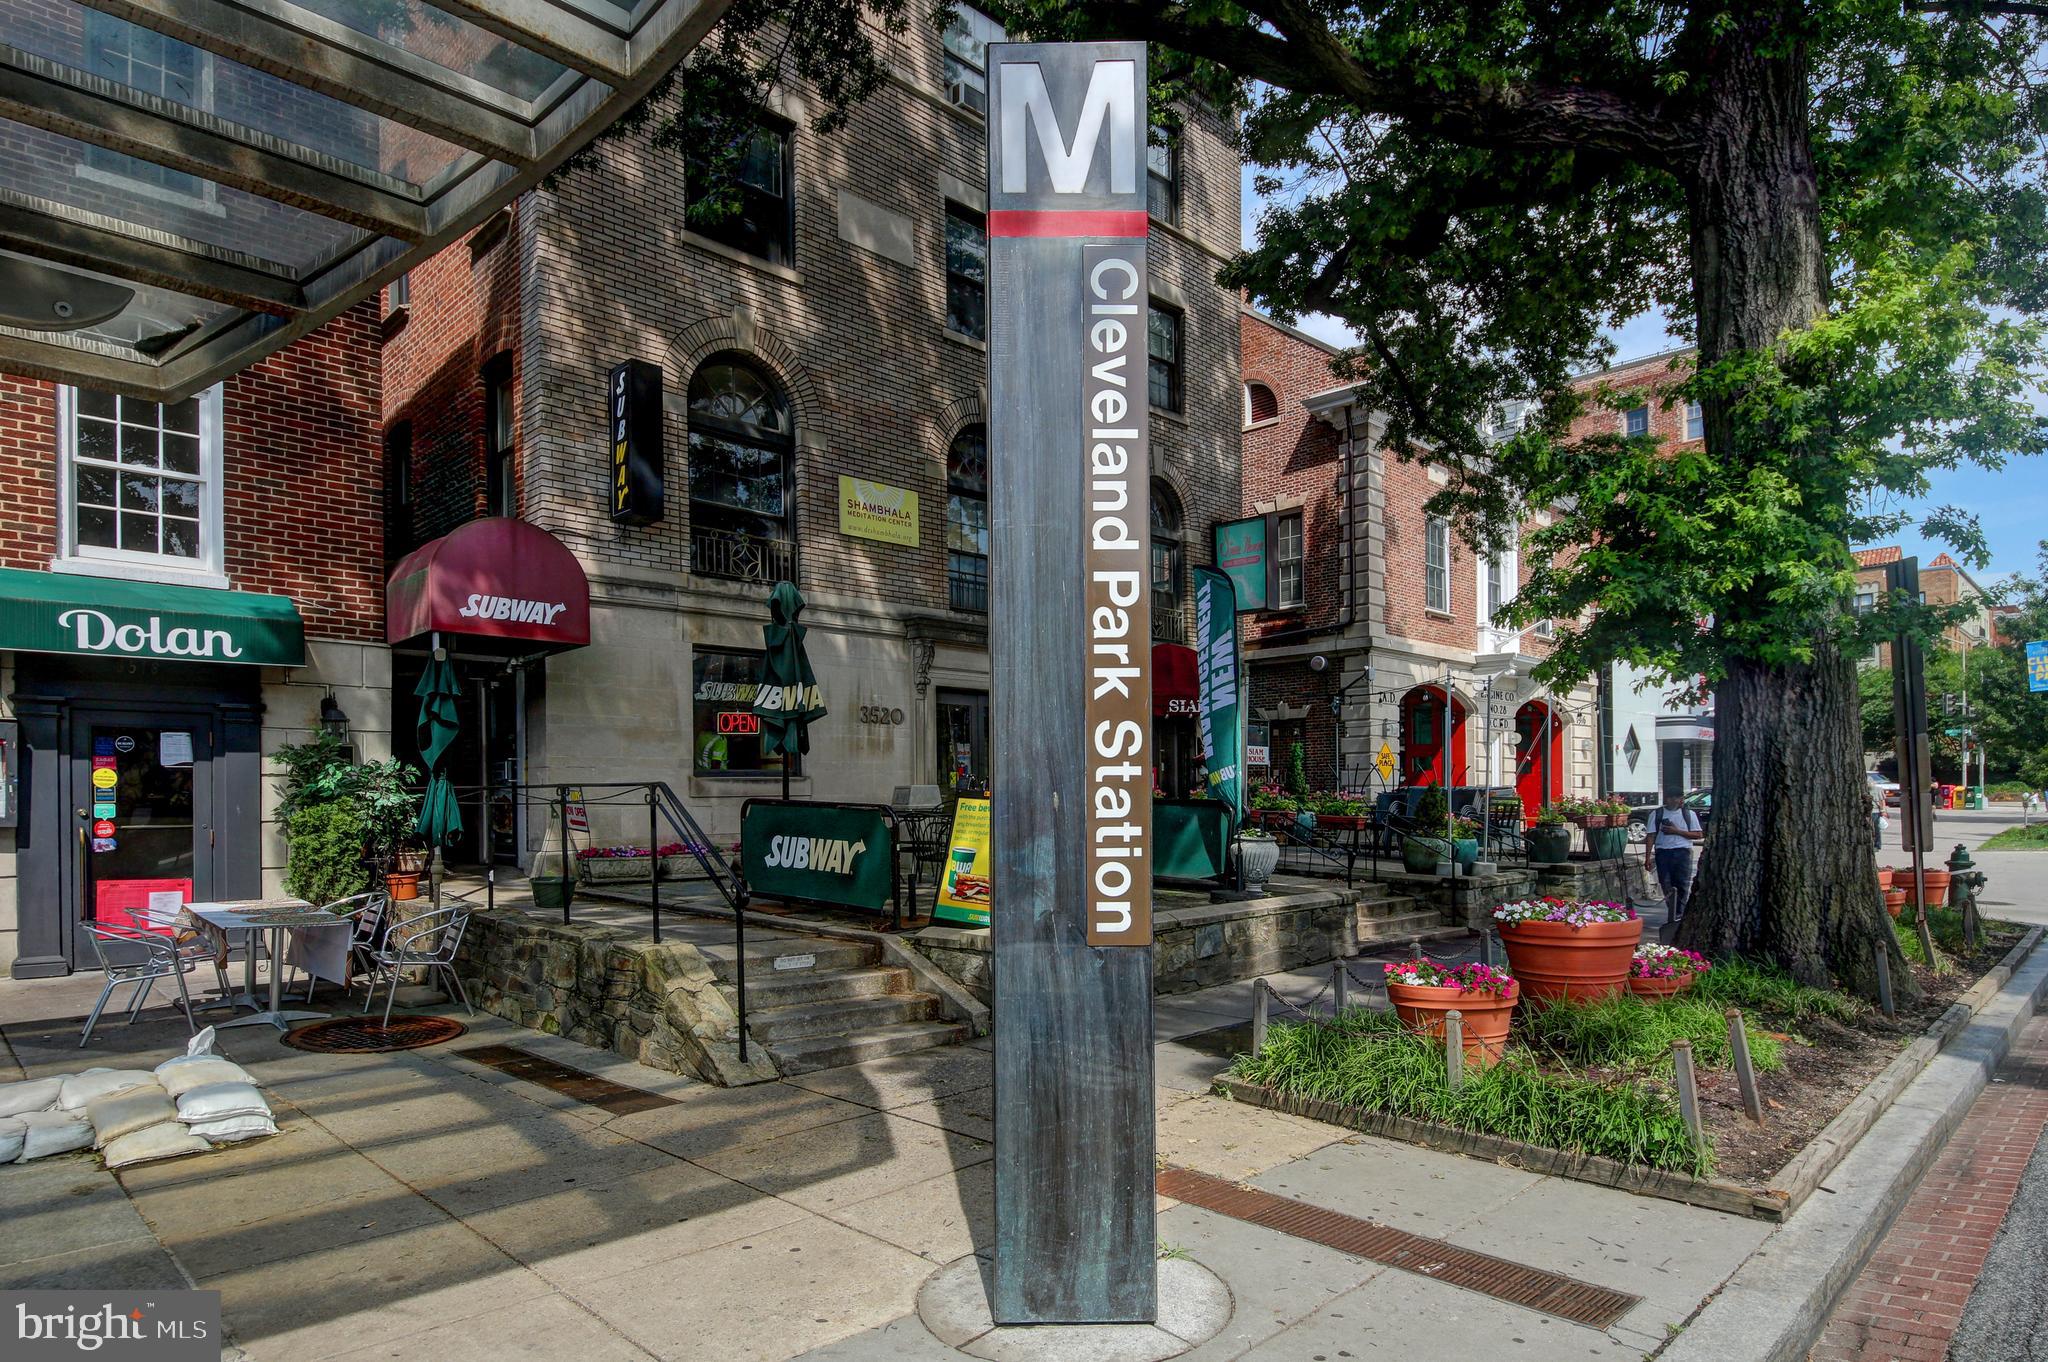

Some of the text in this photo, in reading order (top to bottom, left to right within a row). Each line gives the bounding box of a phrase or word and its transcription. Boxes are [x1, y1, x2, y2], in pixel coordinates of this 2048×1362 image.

[1000, 61, 1136, 194] M
[616, 371, 629, 510] SUBWAY
[847, 498, 912, 520] SHAMBHALA
[847, 510, 913, 528] MEDITATION CENTER
[1090, 258, 1144, 933] Cleveland Park Station
[459, 594, 567, 626] SUBWAY
[58, 609, 243, 658] Dolan
[694, 681, 759, 702] SUBWA
[860, 706, 905, 725] 3520
[1169, 699, 1200, 713] SIA
[720, 712, 757, 732] OPEN
[1248, 748, 1264, 756] SIAM
[1380, 752, 1391, 760] SAFE
[959, 802, 977, 812] Free
[764, 834, 867, 875] SUBWAY
